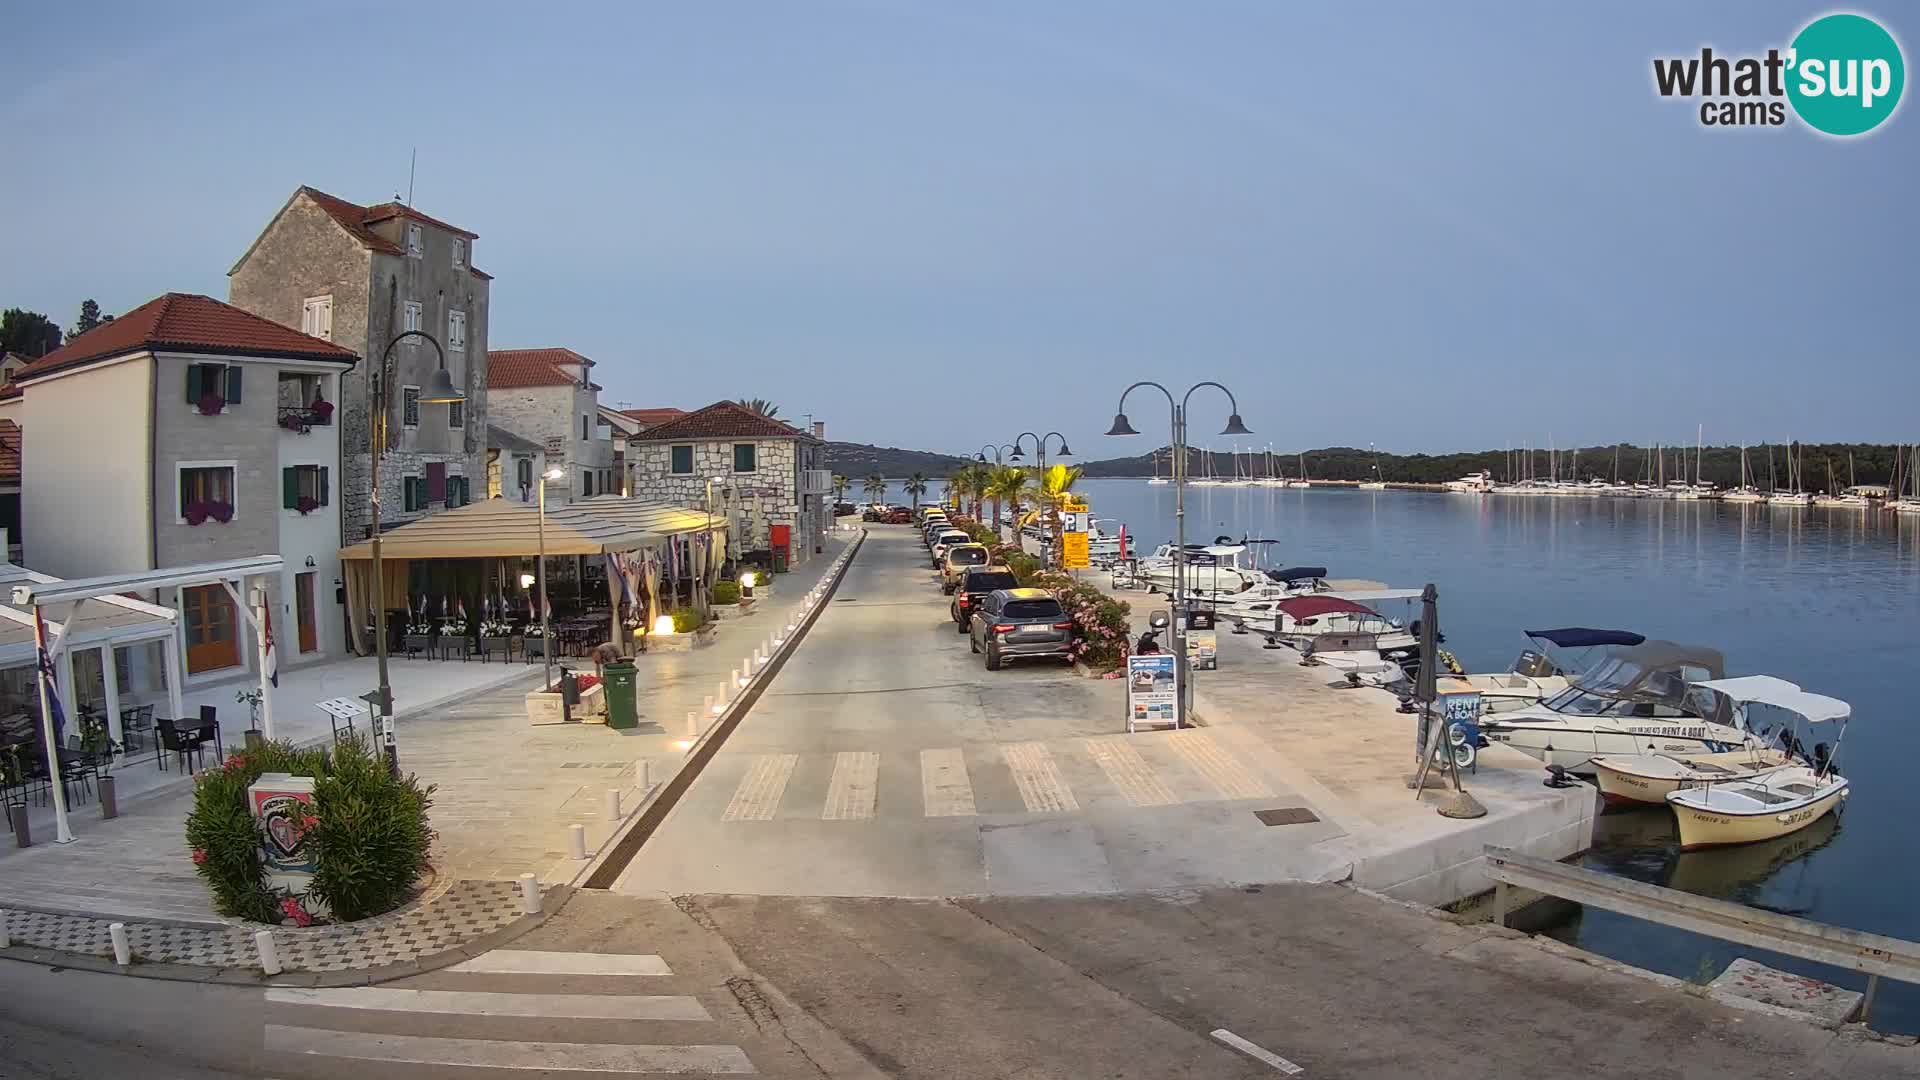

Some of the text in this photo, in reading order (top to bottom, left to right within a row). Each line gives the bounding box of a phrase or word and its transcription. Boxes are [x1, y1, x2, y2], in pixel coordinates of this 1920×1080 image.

[1065, 514, 1075, 530] P
[1447, 699, 1479, 711] RENT
[1446, 710, 1477, 719] A BOAT
[1661, 727, 1681, 736] RENT
[1681, 727, 1687, 736] A
[1687, 727, 1706, 738] BOAT
